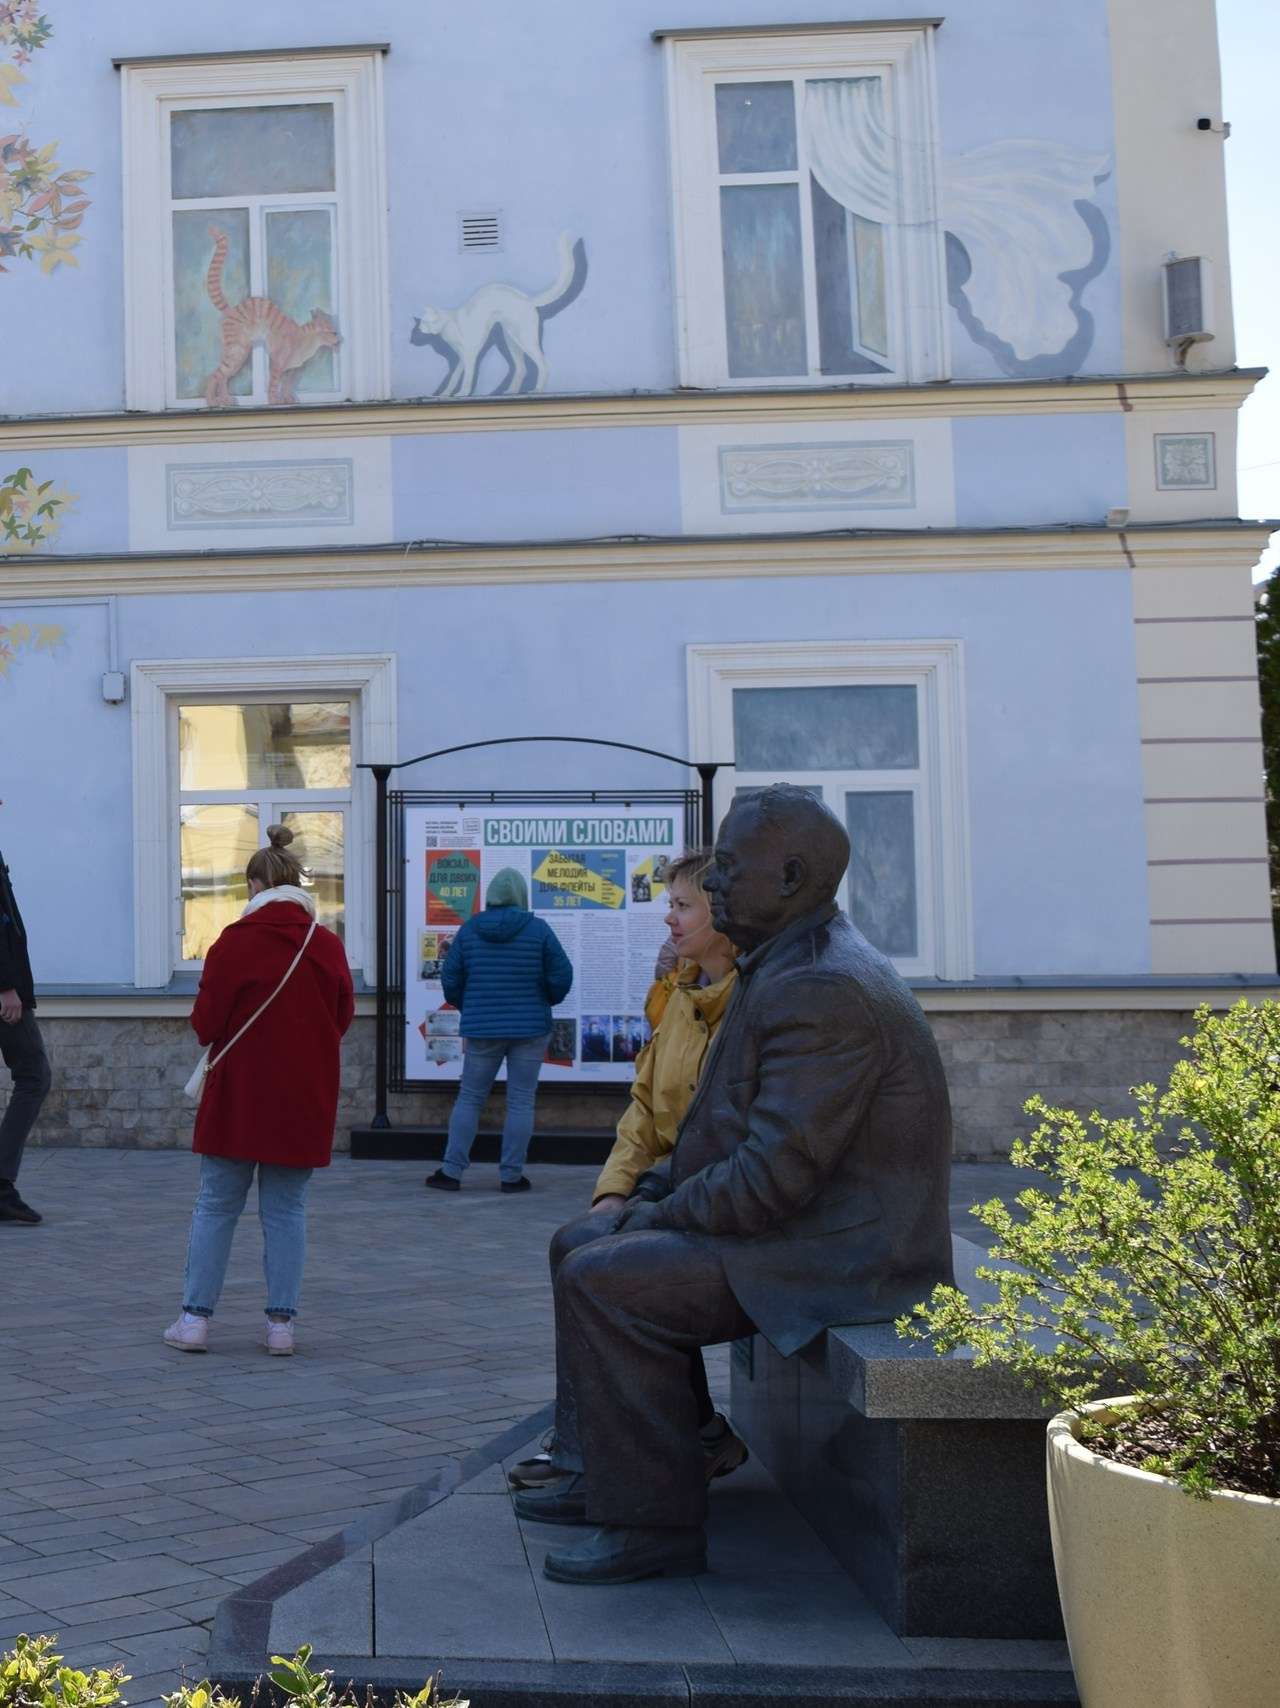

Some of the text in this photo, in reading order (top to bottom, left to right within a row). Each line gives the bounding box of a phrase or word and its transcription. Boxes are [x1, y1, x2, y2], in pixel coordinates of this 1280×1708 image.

[487, 820, 567, 844] СВОИМИ
[572, 820, 668, 844] СЛОВАМИ
[437, 858, 470, 869] ВОКЗАЛ
[548, 853, 586, 864] ЗАБЫТАЯ
[547, 867, 588, 878] МЕЛОДИЯ
[429, 873, 477, 884] ДЛЯ ДВОИХ
[439, 886, 468, 897] 40 ЛЕТ
[539, 880, 596, 893] ДЛЯ ФЛЕЙТЫ
[553, 896, 582, 907] 35 ЛЕТ
